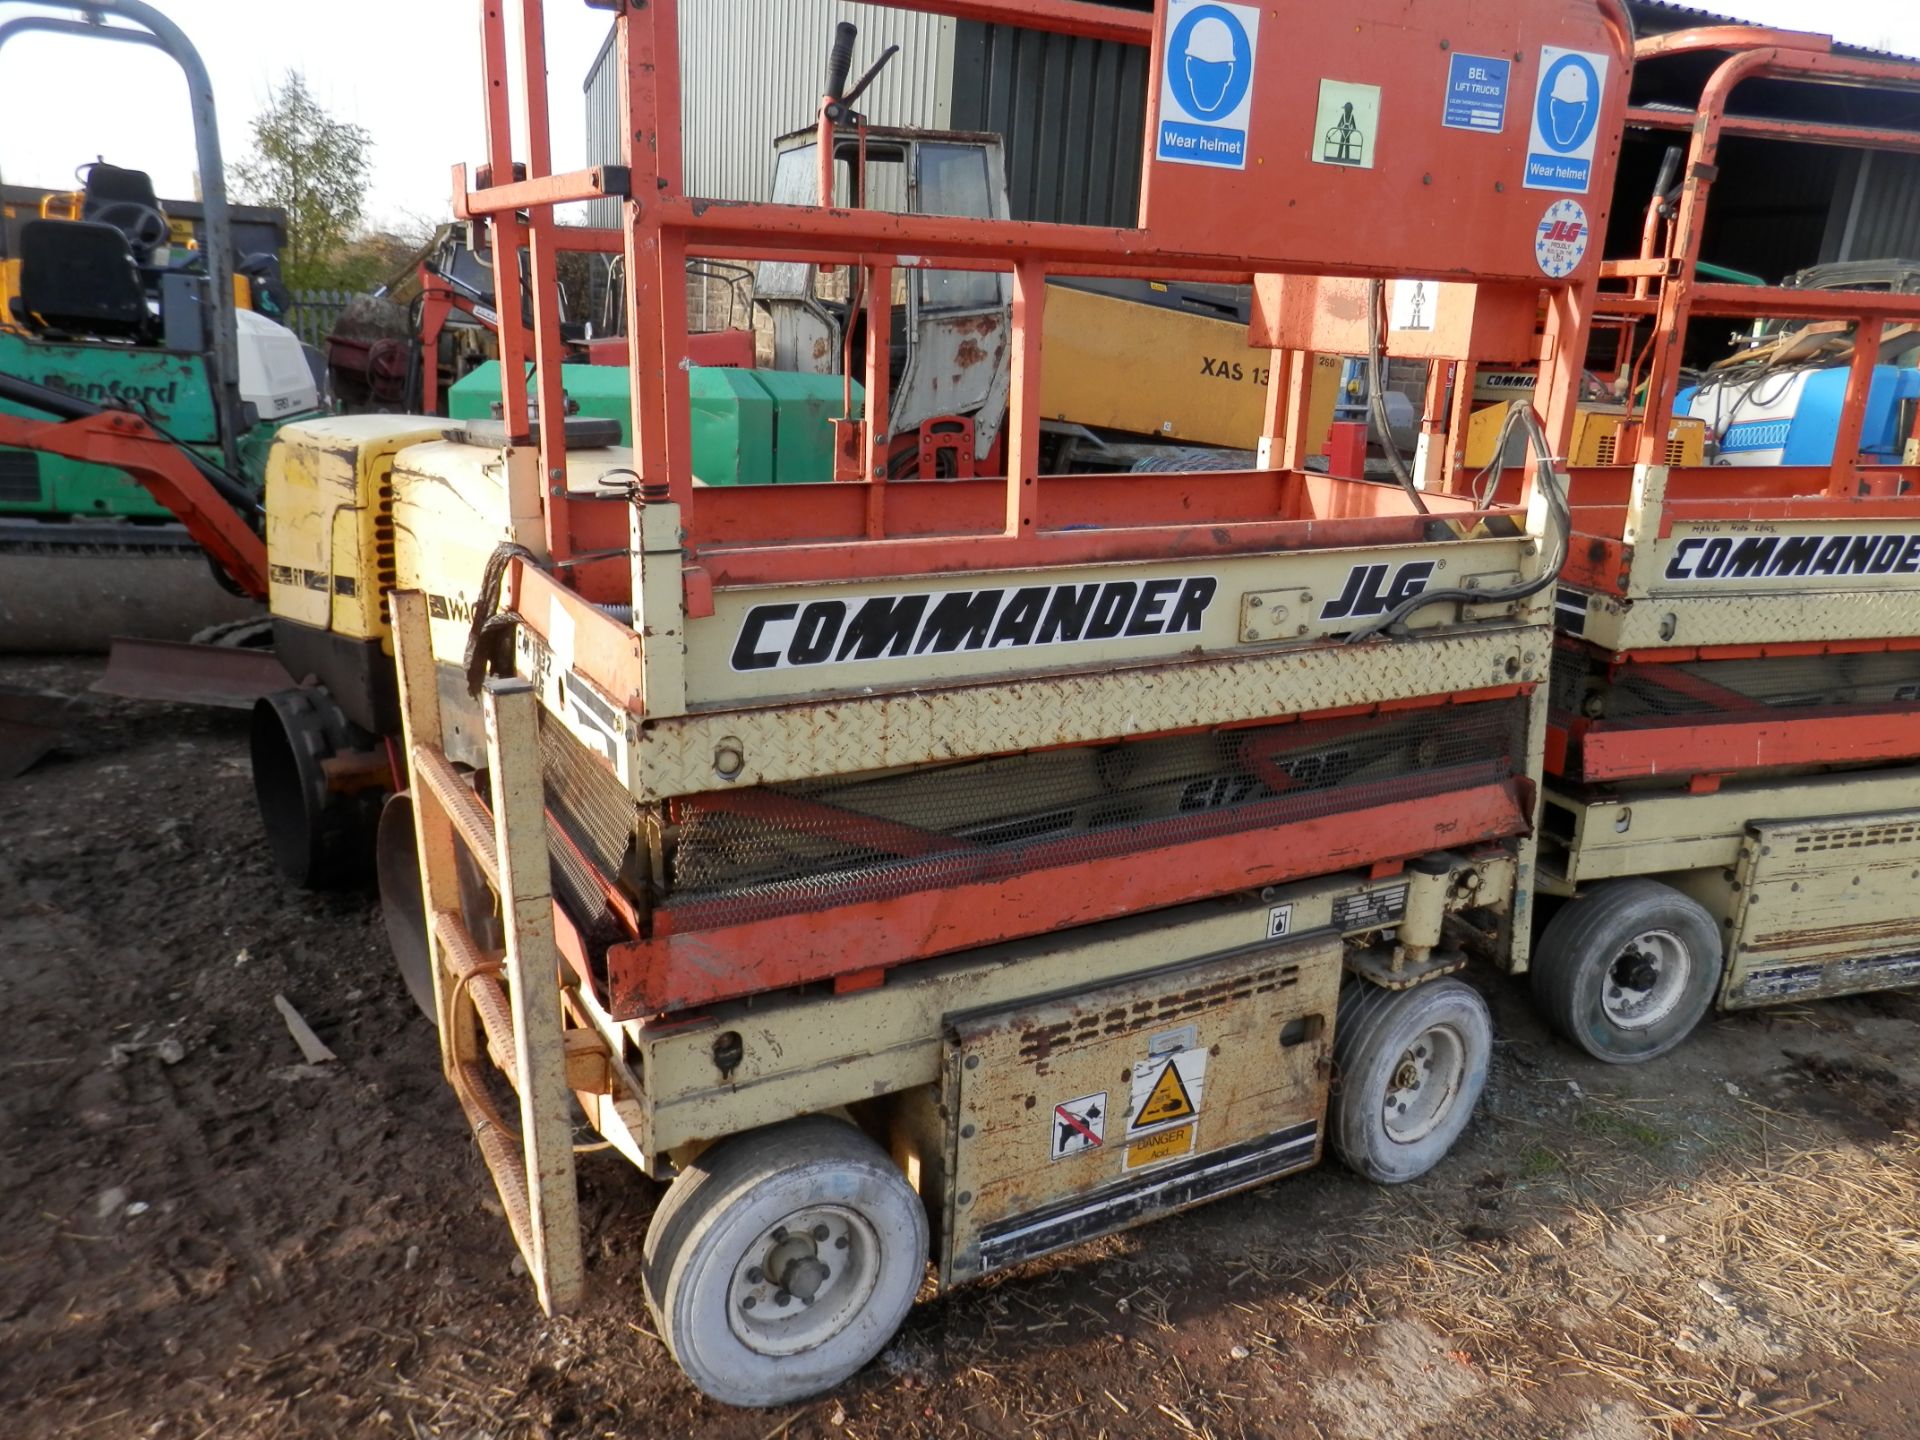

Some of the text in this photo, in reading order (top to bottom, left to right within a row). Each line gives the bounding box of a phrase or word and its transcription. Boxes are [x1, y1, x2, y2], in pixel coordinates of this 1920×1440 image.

[1468, 67, 1488, 81] BEL
[1454, 82, 1500, 96] LIFT TRUCKS
[1164, 131, 1241, 154] Wear helmet
[1530, 162, 1587, 180] Wear helmet
[1543, 220, 1583, 243] JLG
[1200, 356, 1244, 381] XAS
[1319, 356, 1336, 368] 260
[1320, 561, 1436, 619] JLG
[730, 576, 1218, 671] COMMANDER
[1137, 1129, 1185, 1150] DANGER
